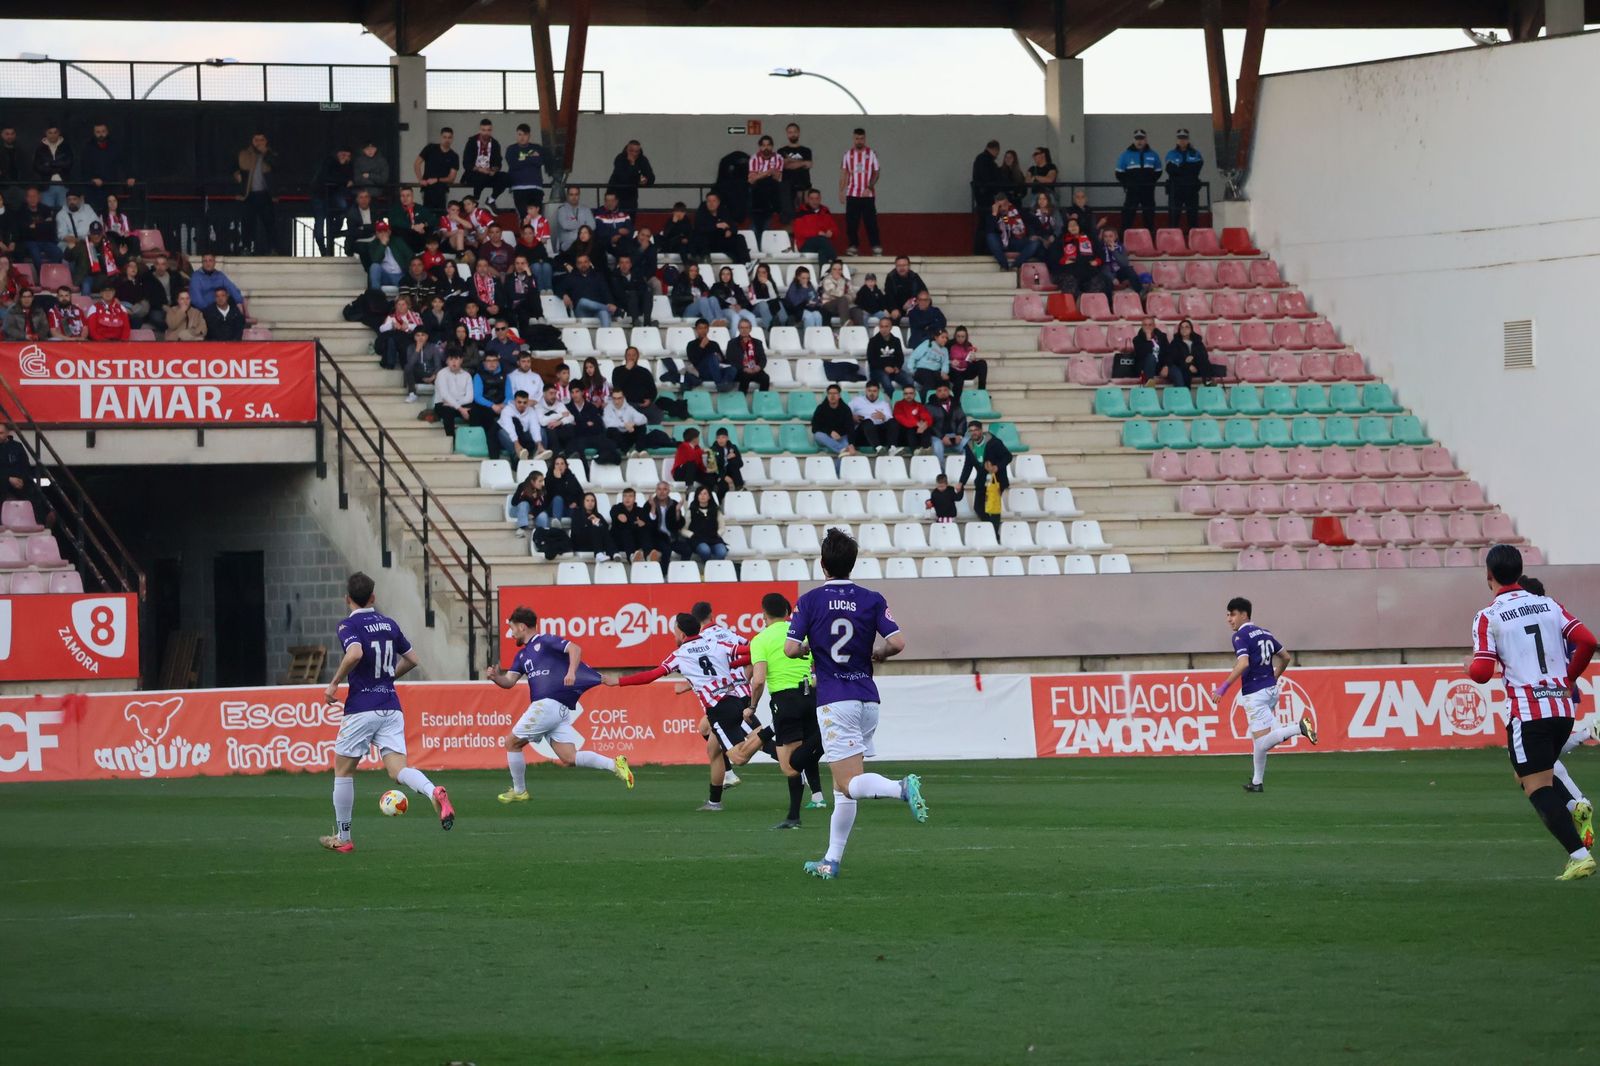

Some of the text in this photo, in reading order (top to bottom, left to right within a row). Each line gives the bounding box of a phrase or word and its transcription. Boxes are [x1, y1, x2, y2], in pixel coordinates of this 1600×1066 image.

[245, 403, 279, 418] S.A.
[829, 599, 857, 612] LUCAS
[91, 606, 115, 646] 8
[58, 626, 99, 673] ZAMORA
[831, 618, 854, 664] 2
[1257, 640, 1275, 665] 10
[1524, 623, 1548, 674] 7
[371, 640, 396, 678] 14
[698, 655, 718, 676] 8
[1051, 676, 1219, 716] FUNDACIÓN
[421, 710, 512, 727] Escucha todos
[589, 709, 628, 724] COPE
[422, 732, 440, 748] los
[443, 732, 495, 752] partidos
[591, 725, 655, 740] ZAMORA
[1053, 715, 1219, 754] ZAMORACF
[593, 741, 615, 751] 1269
